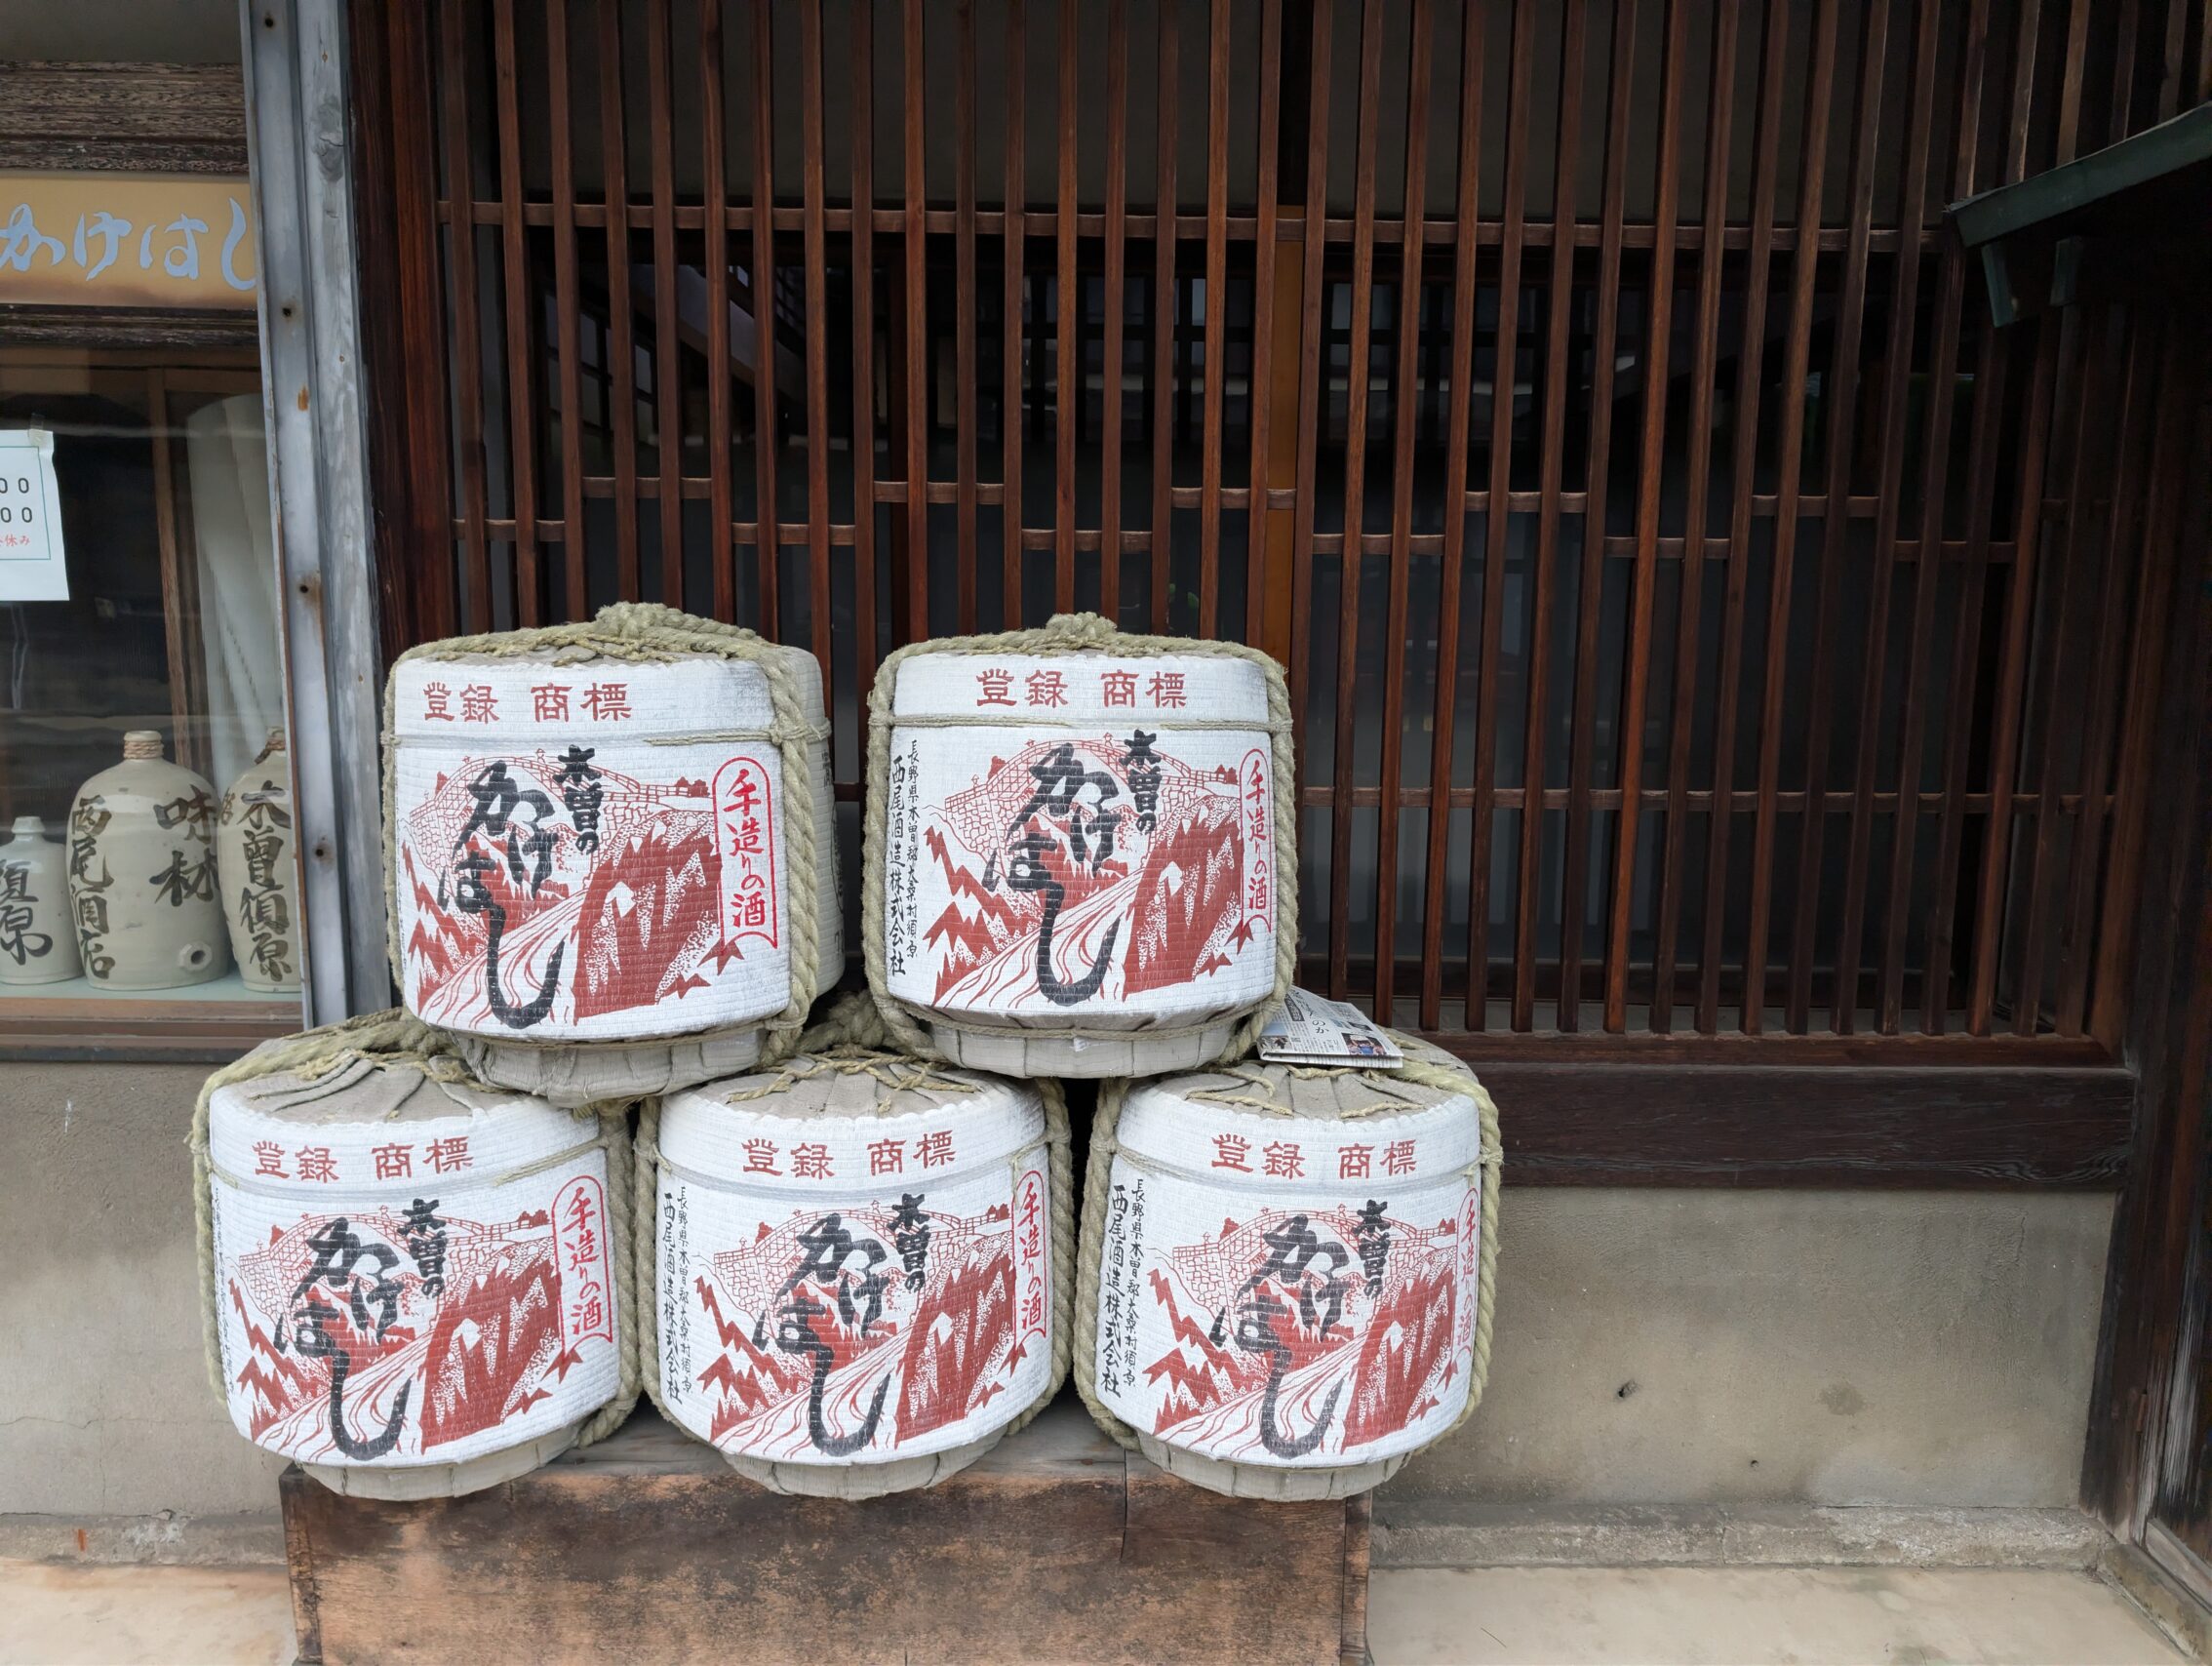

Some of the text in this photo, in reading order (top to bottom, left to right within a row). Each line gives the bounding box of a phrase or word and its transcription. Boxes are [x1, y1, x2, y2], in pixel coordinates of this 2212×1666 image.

[0, 196, 257, 291] かけはし
[0, 534, 30, 546] 休み
[422, 681, 633, 724] 登録 商標
[975, 668, 1188, 709] 登録 商標
[889, 754, 906, 976] 西尾酒造株式会社
[253, 1136, 474, 1183] 登録 商標
[741, 1130, 956, 1179] 登録 商標
[1211, 1133, 1418, 1179] 登録 商標
[1100, 1185, 1128, 1398] 西尾酒造株式会社
